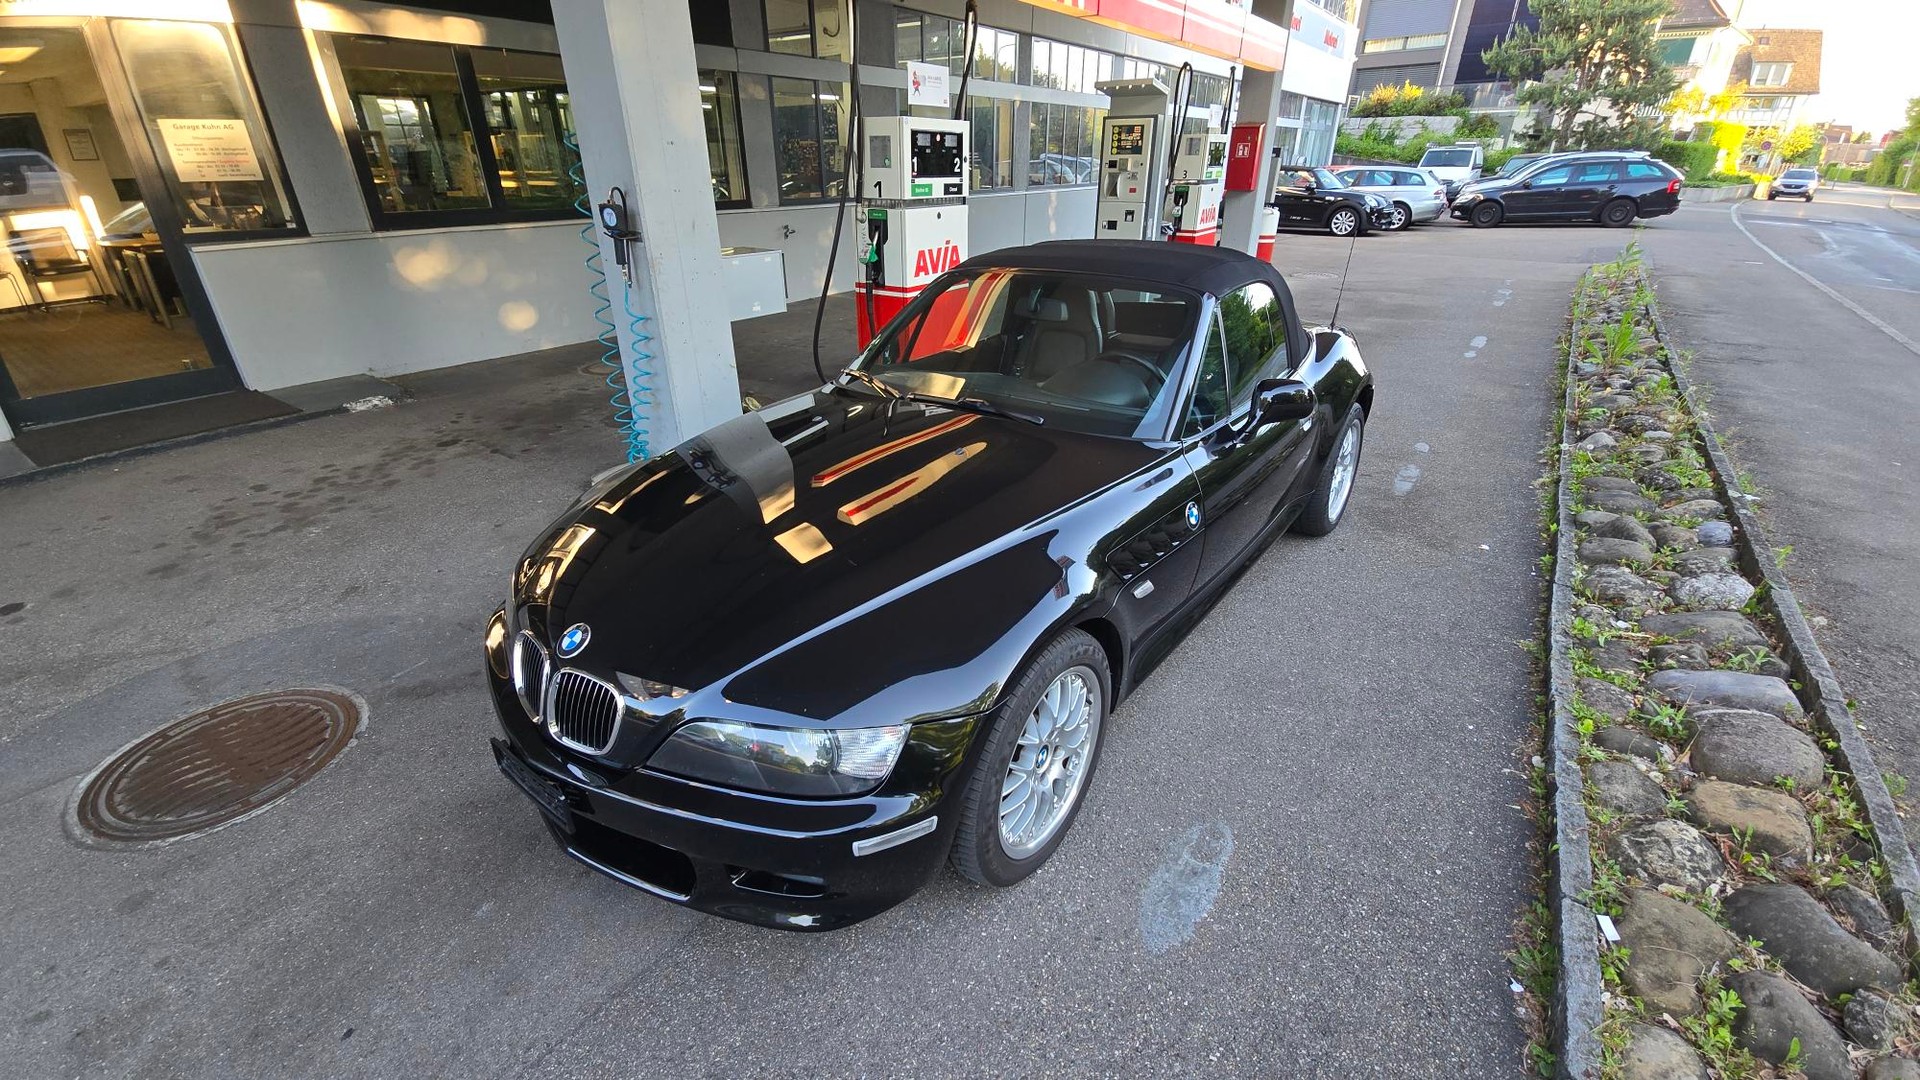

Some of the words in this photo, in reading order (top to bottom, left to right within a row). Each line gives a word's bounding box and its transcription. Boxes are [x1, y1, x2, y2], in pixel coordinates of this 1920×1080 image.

[173, 123, 200, 131] Garage
[912, 156, 918, 173] 1
[953, 157, 961, 173] 2
[1183, 170, 1188, 179] 3
[873, 180, 883, 198] 1
[1200, 204, 1216, 224] AVIA
[914, 240, 961, 278] AVIA
